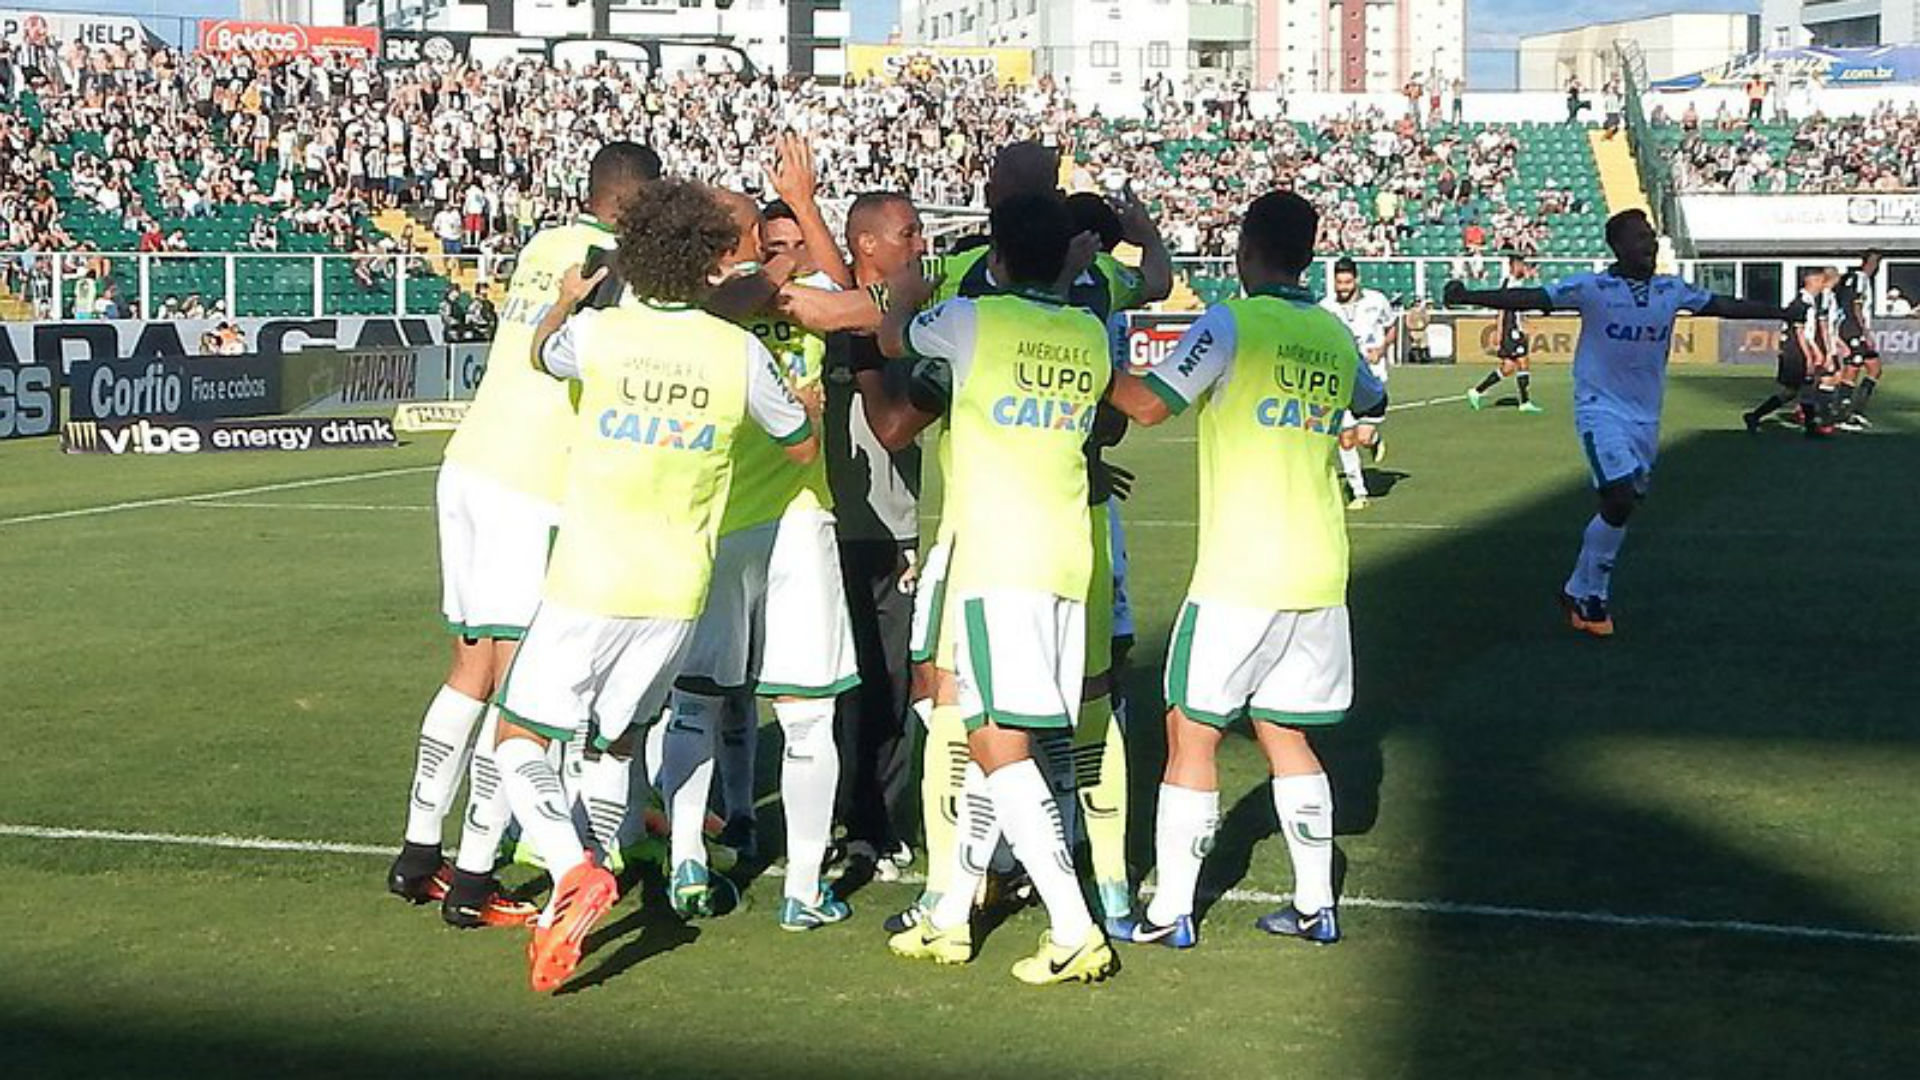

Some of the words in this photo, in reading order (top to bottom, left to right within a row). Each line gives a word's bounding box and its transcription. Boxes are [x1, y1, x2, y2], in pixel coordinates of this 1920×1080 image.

[78, 23, 136, 44] HELP
[90, 362, 182, 419] Corfio
[617, 376, 710, 410] LUPO
[1014, 361, 1094, 393] LUPO
[599, 408, 717, 452] CAIXA
[992, 395, 1098, 433] CAIXA
[1256, 397, 1345, 436] CAXA
[212, 423, 313, 450] energy
[320, 418, 395, 444] drink
